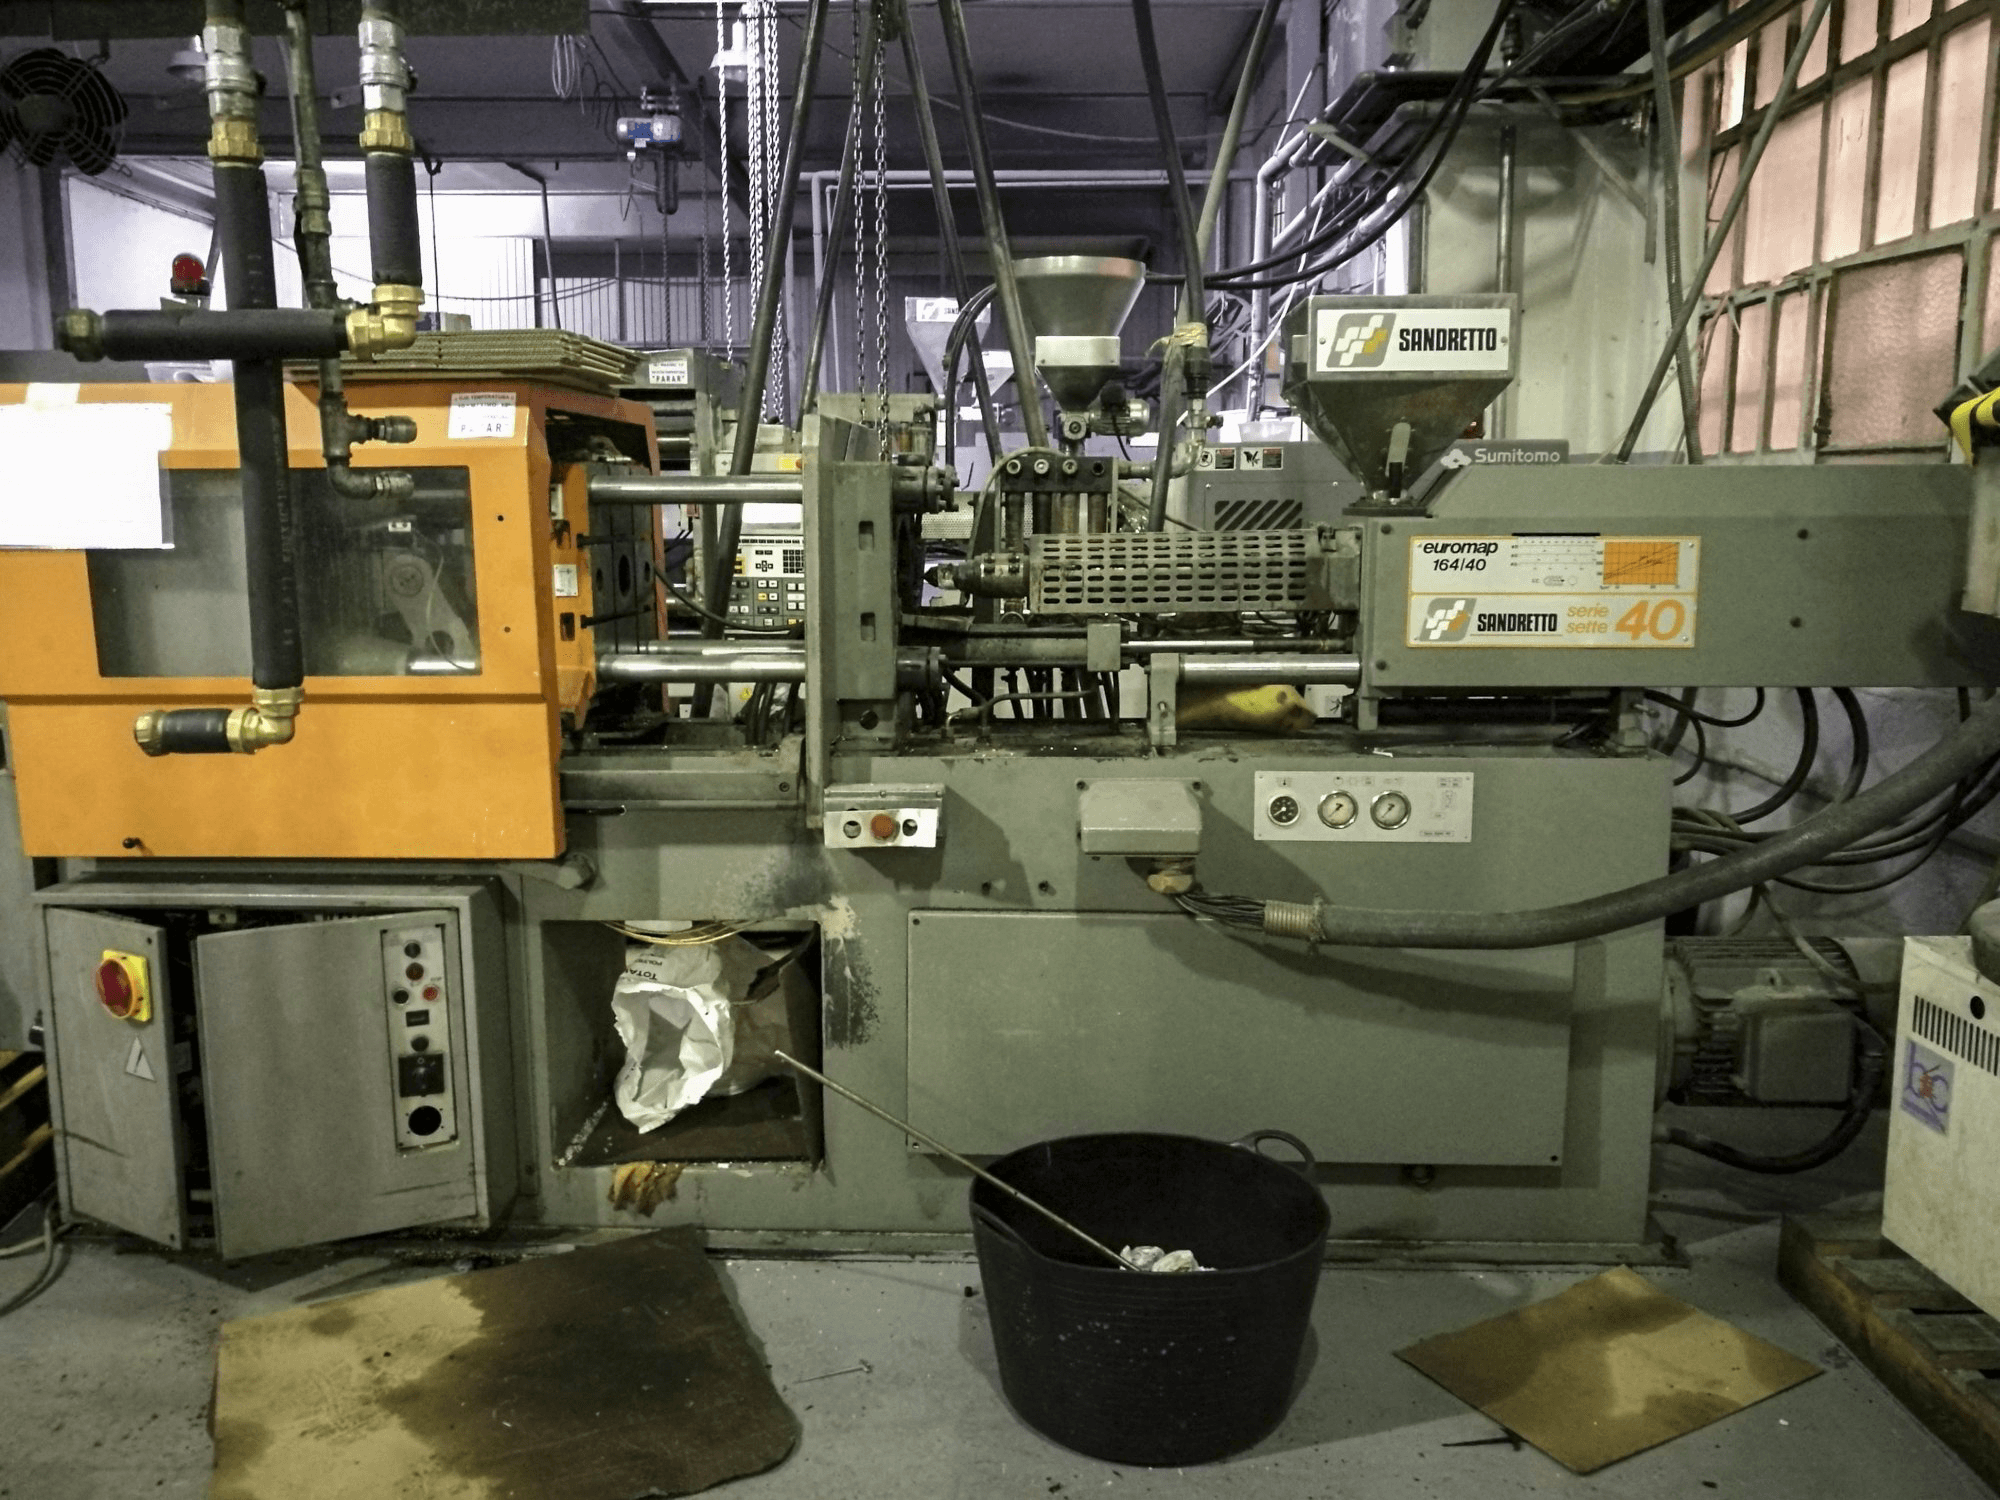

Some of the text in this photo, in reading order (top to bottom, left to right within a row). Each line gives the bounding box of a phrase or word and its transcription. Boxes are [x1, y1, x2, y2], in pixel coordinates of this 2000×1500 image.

[1398, 327, 1497, 352] SANDRETTO
[1474, 447, 1560, 463] Sumitomo
[1423, 542, 1498, 556] euromap
[1433, 558, 1487, 571] 164/40
[1566, 602, 1610, 618] serie
[1477, 613, 1558, 632] SANDRETTO
[1565, 619, 1609, 634] sette
[1614, 599, 1686, 641] 40
